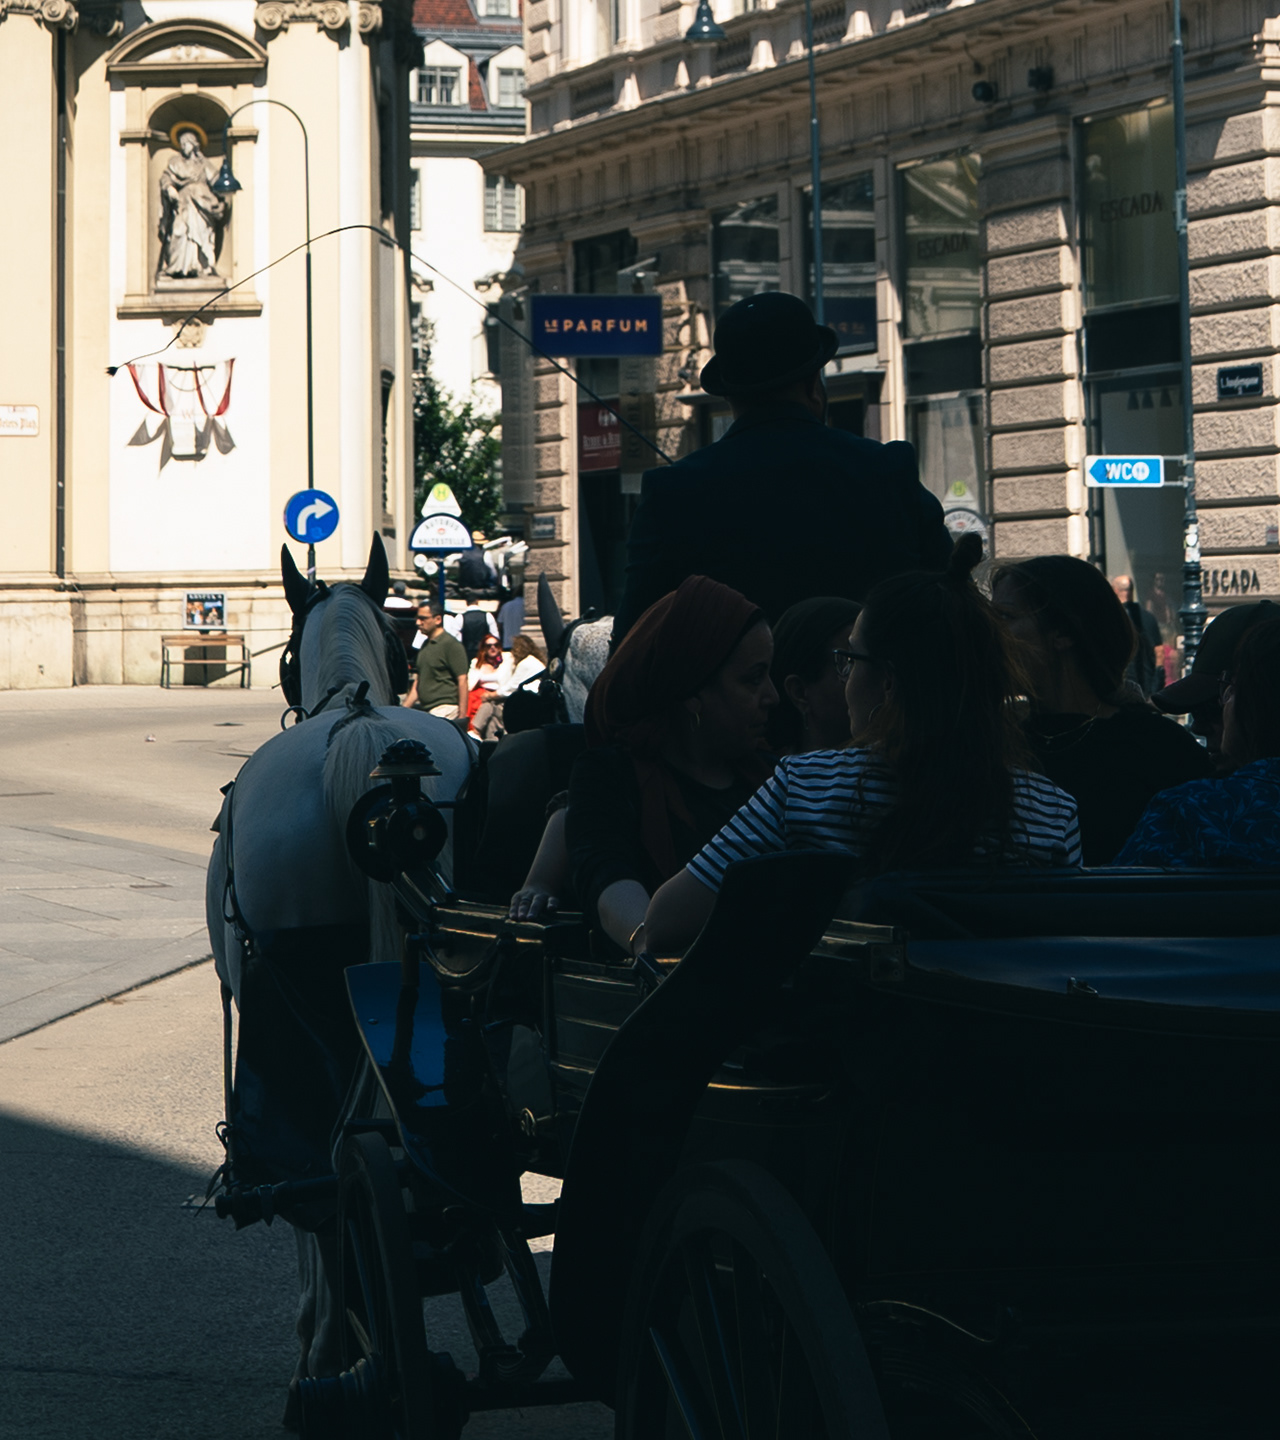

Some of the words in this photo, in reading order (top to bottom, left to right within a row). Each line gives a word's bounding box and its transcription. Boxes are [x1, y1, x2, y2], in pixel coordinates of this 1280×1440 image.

[1100, 191, 1163, 222] ESCADA
[544, 320, 558, 330] LE
[563, 319, 648, 332] PARFUM
[1106, 462, 1132, 480] WC
[438, 487, 446, 496] H
[1203, 568, 1260, 594] ESCADA
